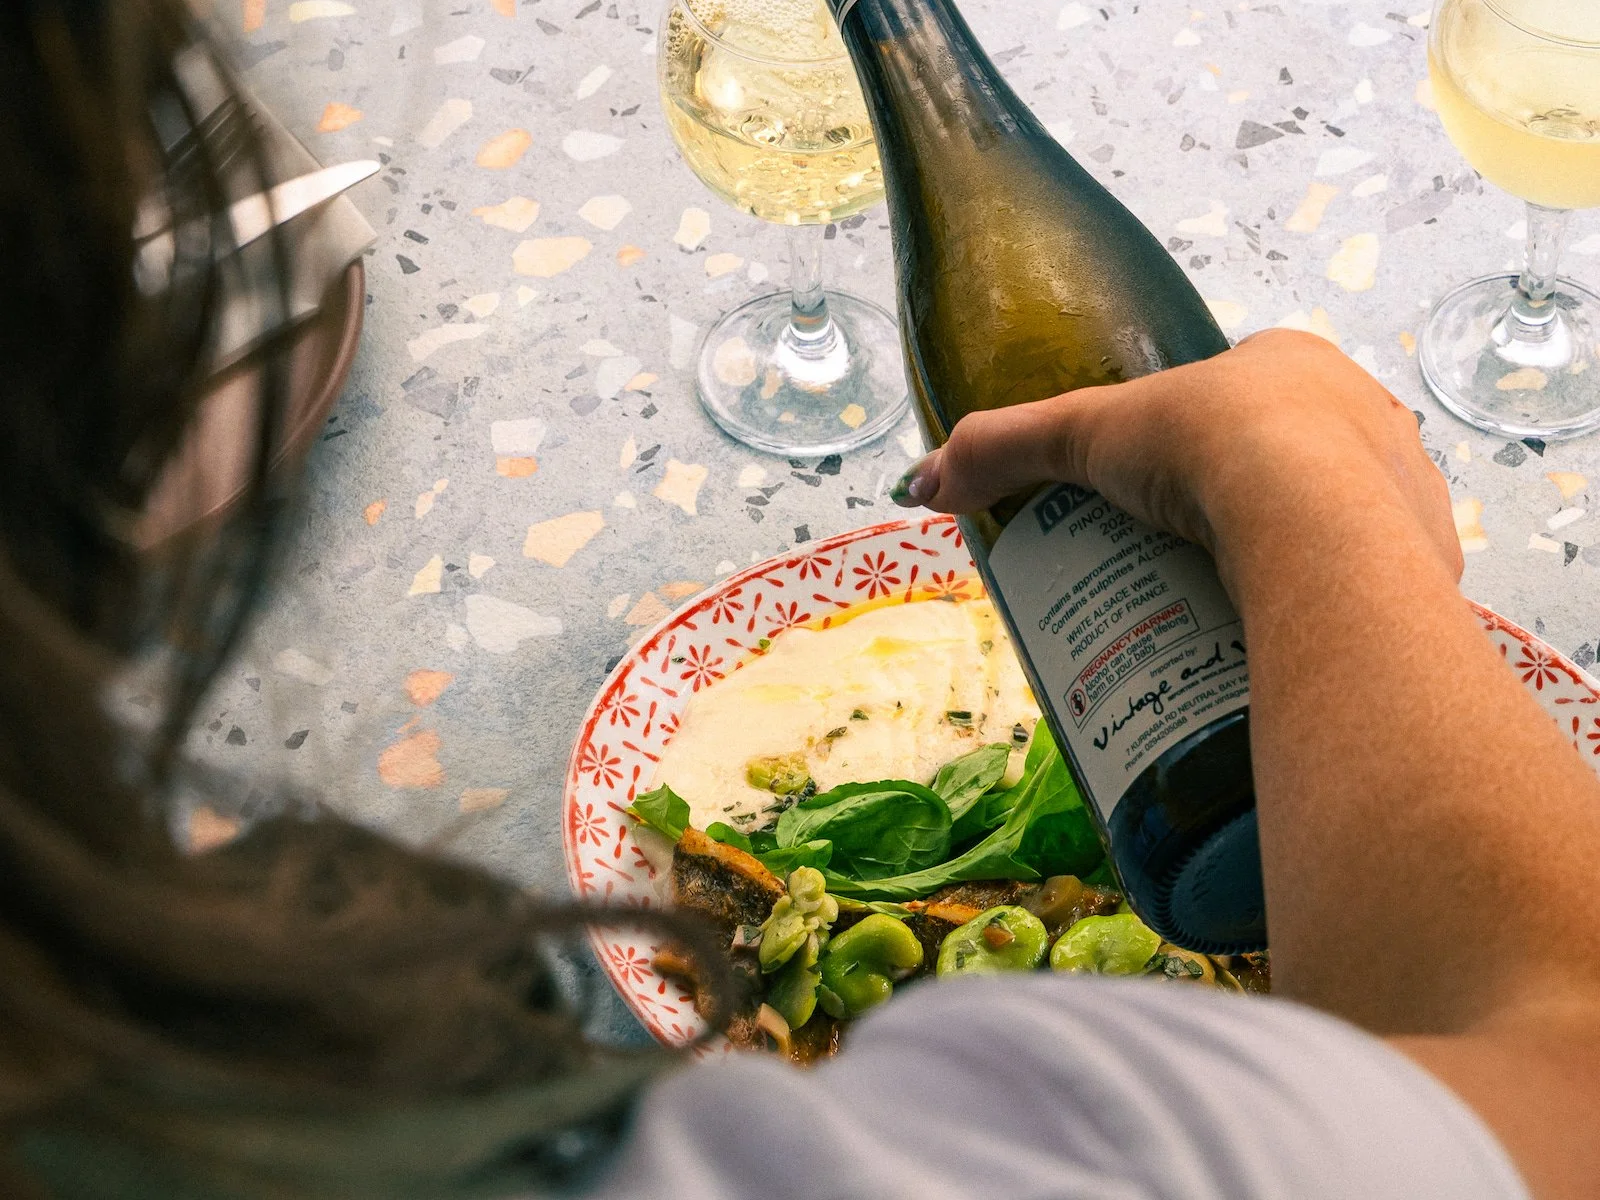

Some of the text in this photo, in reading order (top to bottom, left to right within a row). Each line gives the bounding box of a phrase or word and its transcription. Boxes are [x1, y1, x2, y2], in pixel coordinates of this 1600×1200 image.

[1068, 502, 1113, 537] PINOT
[1110, 524, 1136, 544] DRY
[1039, 592, 1072, 632] Contains
[1072, 540, 1143, 596] approximately
[1051, 597, 1088, 635] Contains
[1088, 562, 1135, 600] sulphites
[1066, 570, 1160, 646] WHITE ALSACE WINE
[1070, 582, 1169, 662] PRODUCT OF FRANCE
[1079, 603, 1185, 686] PREGNANCY WARNING
[1085, 613, 1189, 693] Alcohol can cause lifelong
[1087, 642, 1156, 704] harm to your baby
[1150, 653, 1184, 678] Imported
[1093, 642, 1225, 751] Vintage and
[1130, 719, 1164, 751] KURRABA
[1164, 709, 1177, 722] RD
[1177, 688, 1217, 715] NEUTRAL
[1219, 679, 1237, 693] BAY
[1125, 747, 1146, 772] Phone:
